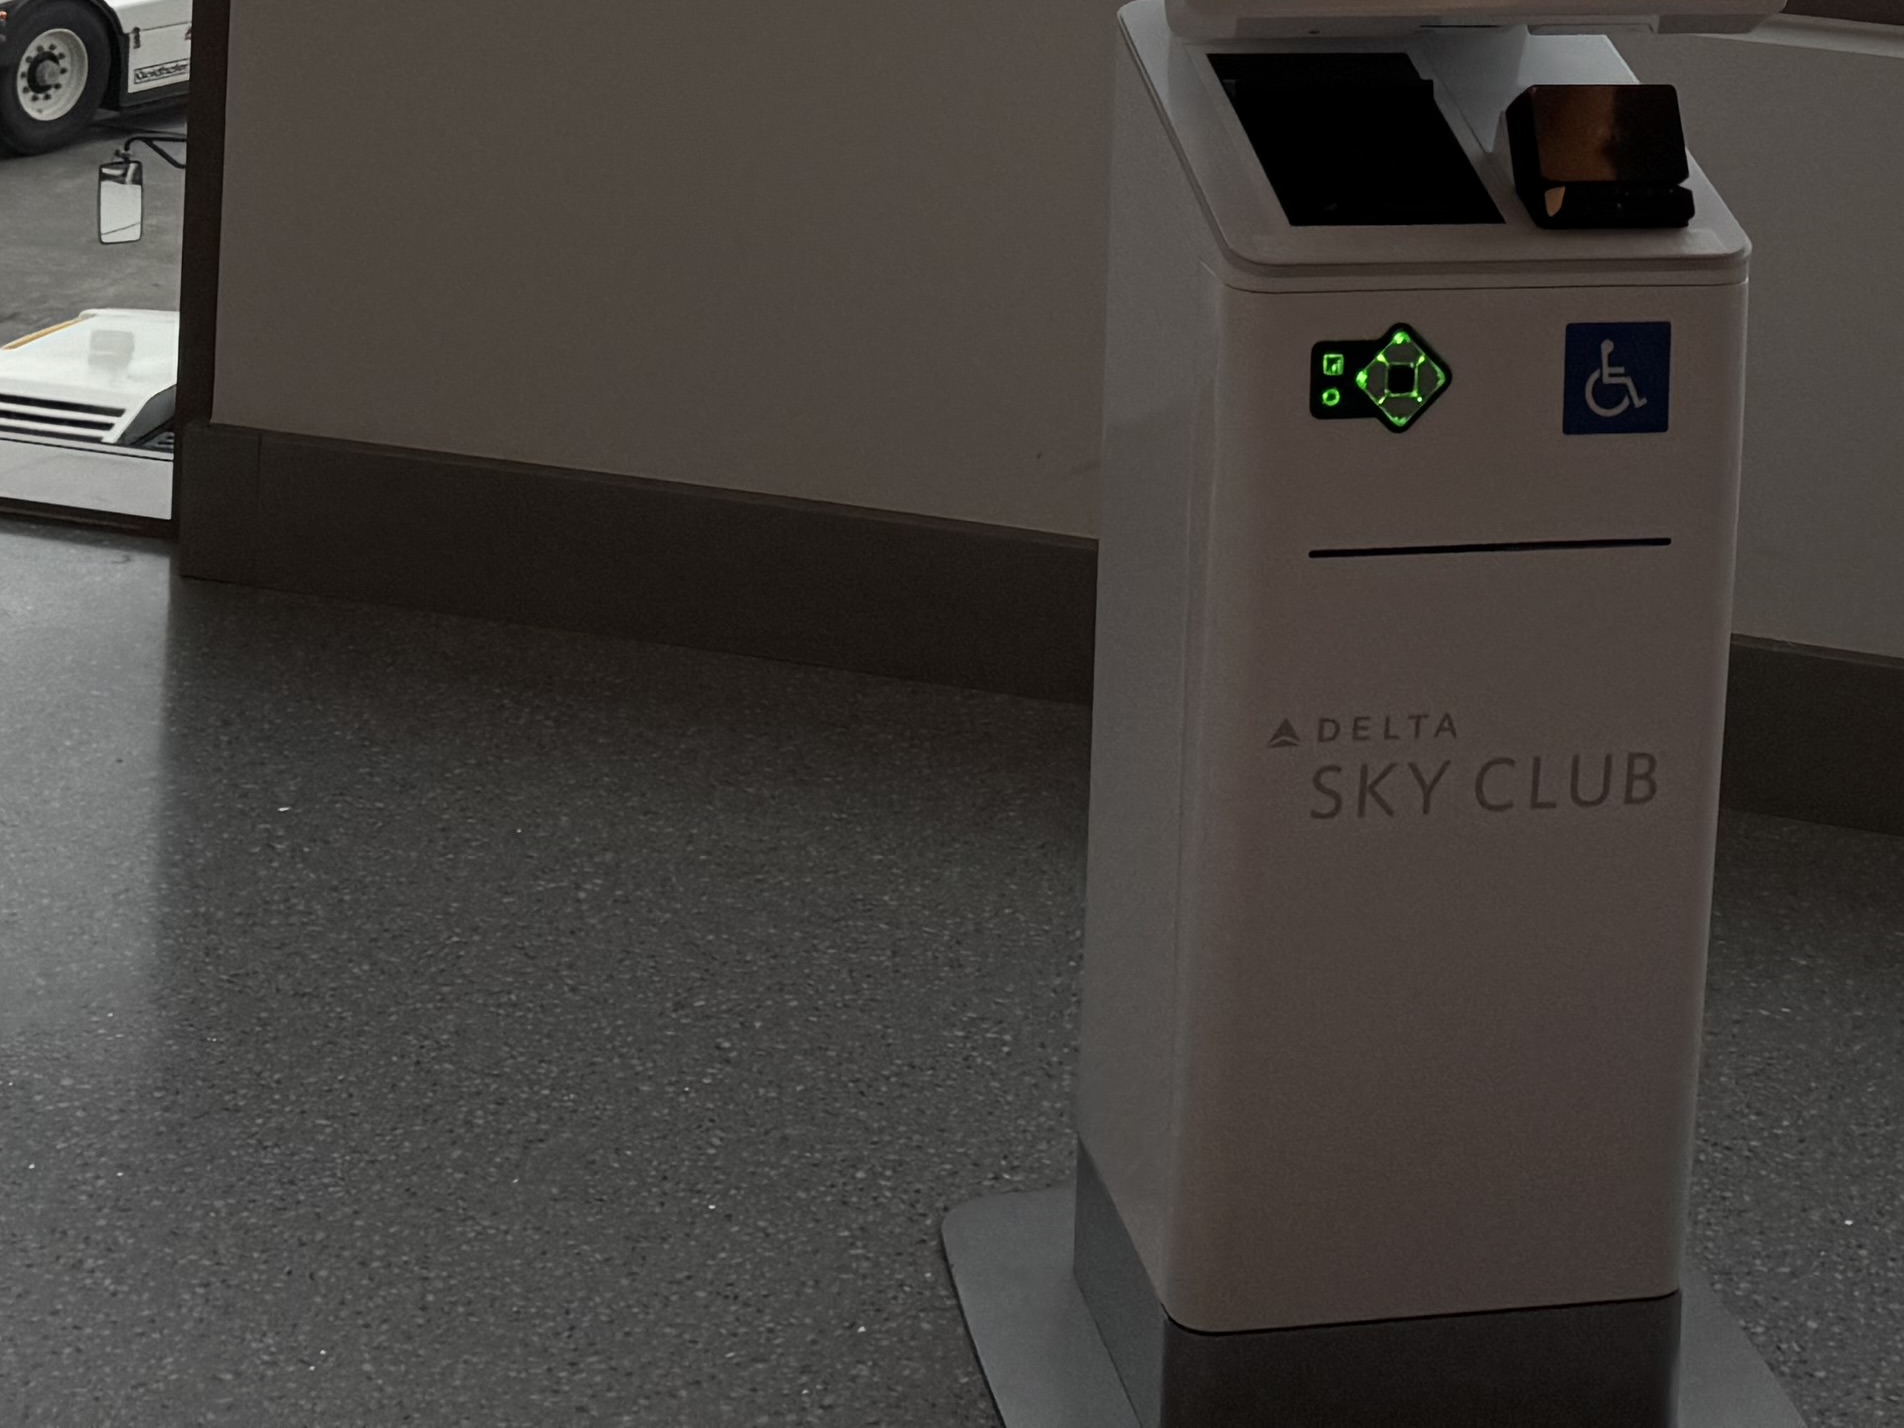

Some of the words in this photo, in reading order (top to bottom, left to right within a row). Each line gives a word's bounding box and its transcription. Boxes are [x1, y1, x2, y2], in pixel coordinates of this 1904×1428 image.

[1317, 713, 1458, 743] DELTA
[1309, 760, 1452, 820] SKY
[1474, 751, 1658, 812] CLUB
